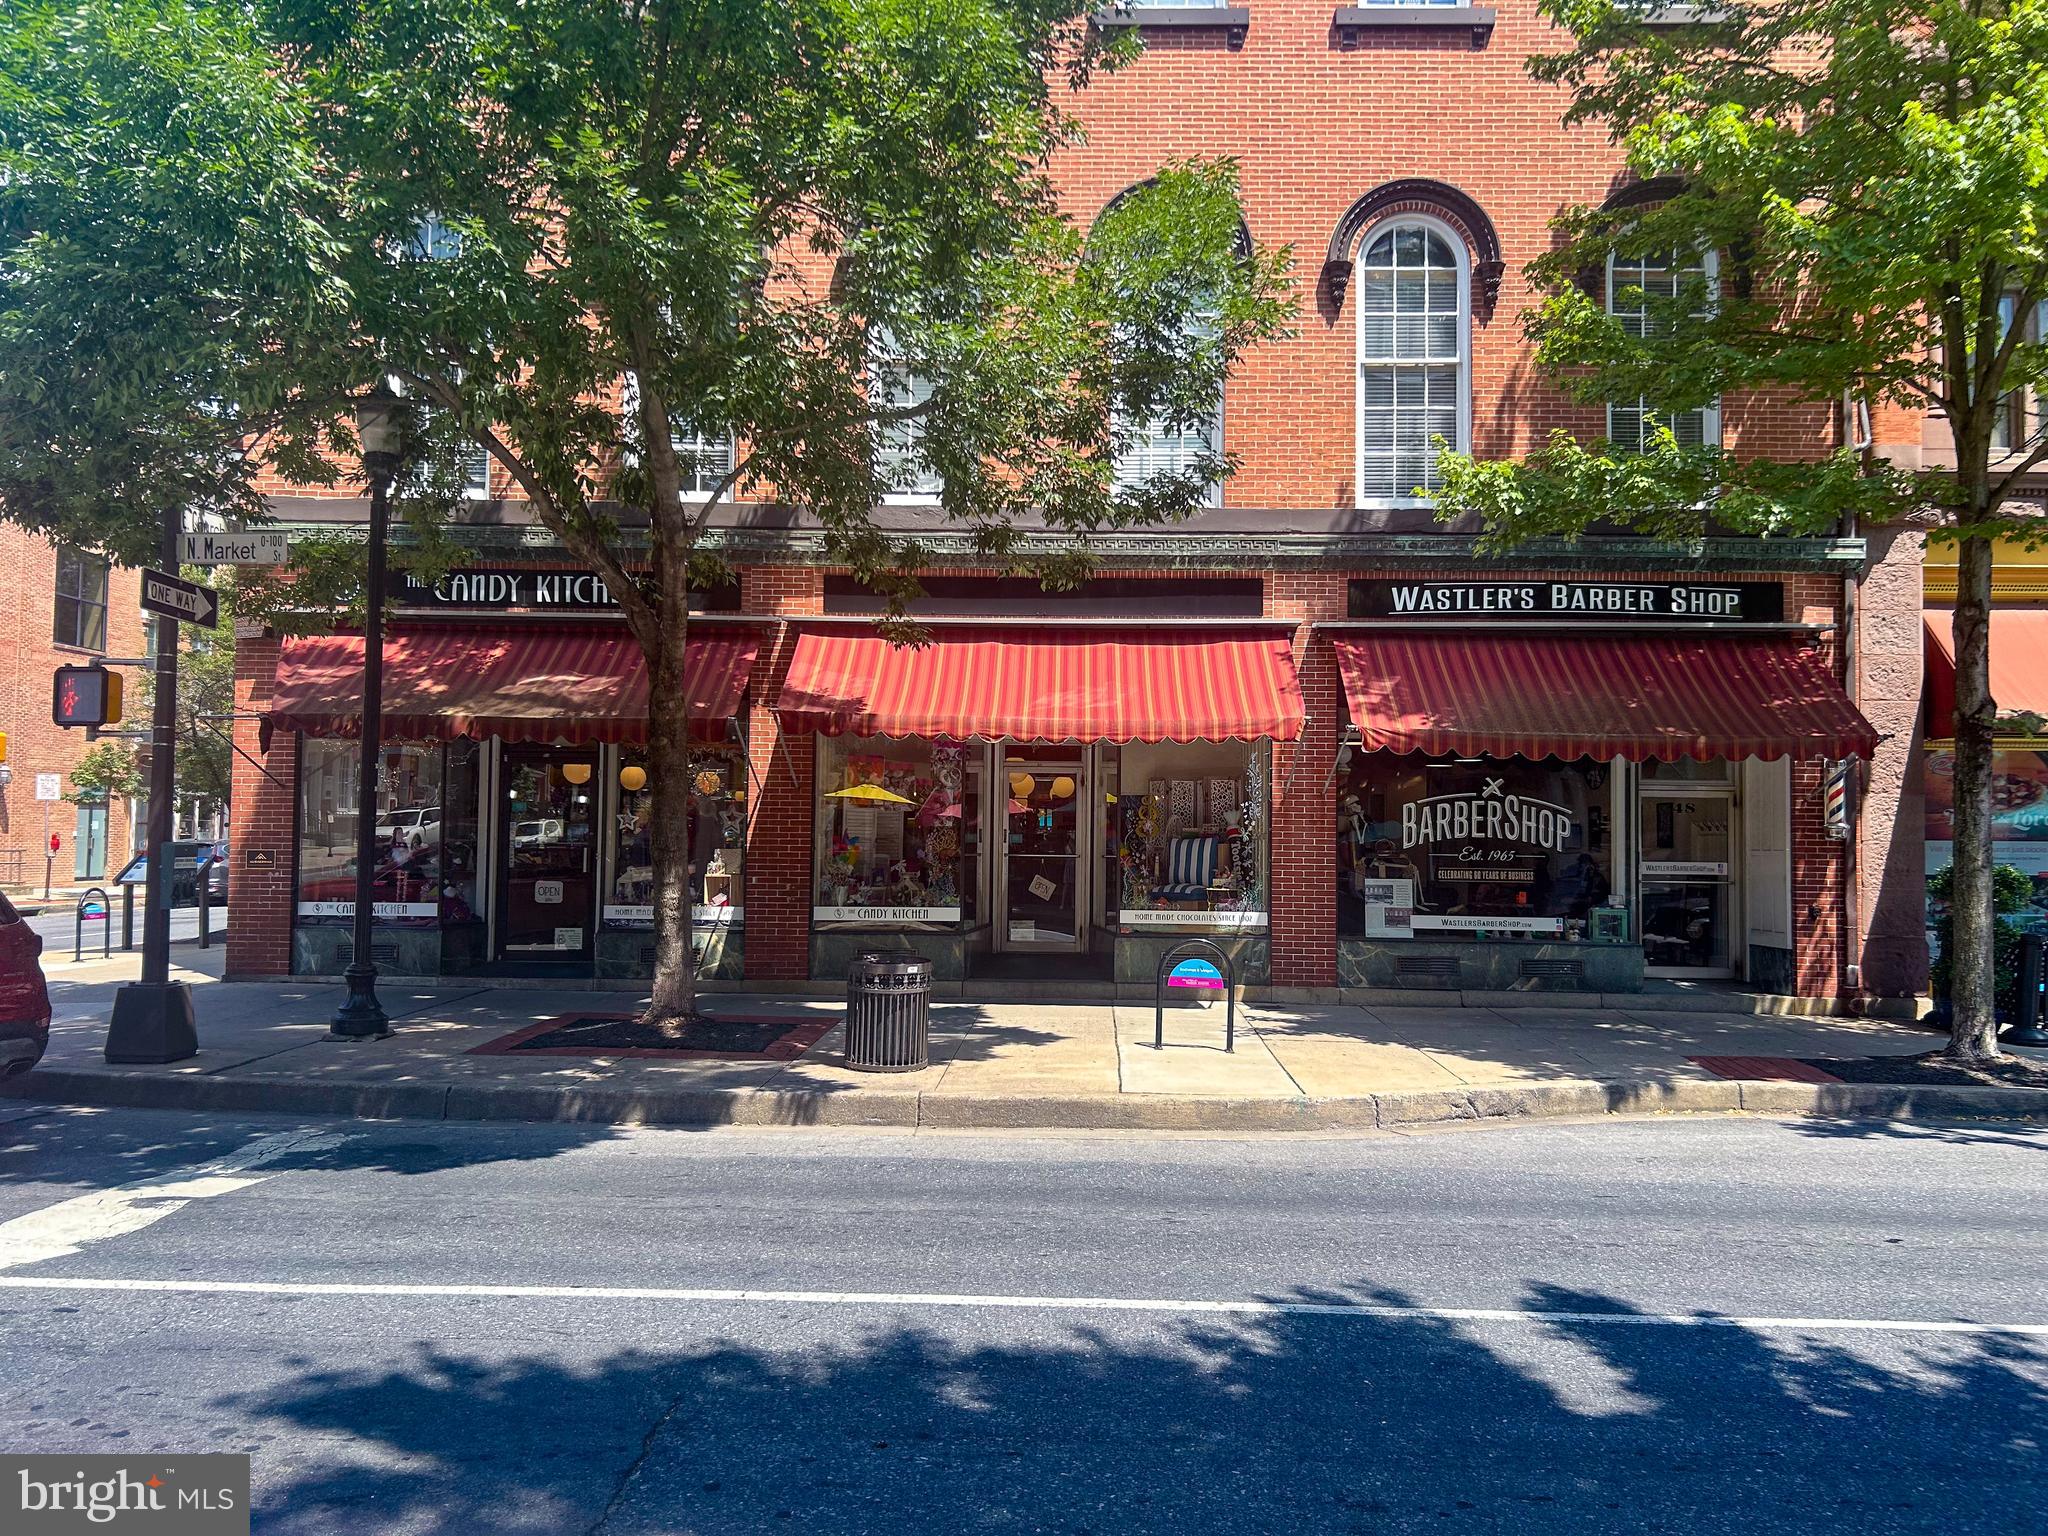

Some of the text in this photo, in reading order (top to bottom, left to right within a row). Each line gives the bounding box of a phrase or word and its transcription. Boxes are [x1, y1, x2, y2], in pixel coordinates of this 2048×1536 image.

[260, 535, 283, 547] 0-100
[187, 537, 257, 560] N. Market
[273, 550, 281, 561] St
[433, 574, 523, 603] CANDY
[536, 575, 619, 604] KITCH
[151, 583, 197, 612] ONE WAY
[1551, 584, 1654, 611] BARBER
[1671, 587, 1740, 614] SHOP
[1458, 846, 1516, 862] Est. 1965
[1438, 870, 1473, 879] CELEBRATING
[1482, 870, 1500, 880] YEARS
[1500, 871, 1508, 880] OF
[1508, 871, 1534, 880] BUSINESS
[538, 886, 561, 897] OPEN
[336, 904, 355, 914] CAN
[372, 904, 408, 915] KITCHEN
[857, 908, 888, 919] CANDY
[892, 908, 929, 919] KITCHEN
[1134, 913, 1153, 921] HOME
[1155, 913, 1175, 921] MADE
[1176, 913, 1217, 922] CHOCOLATES
[1218, 914, 1235, 922] SINCE
